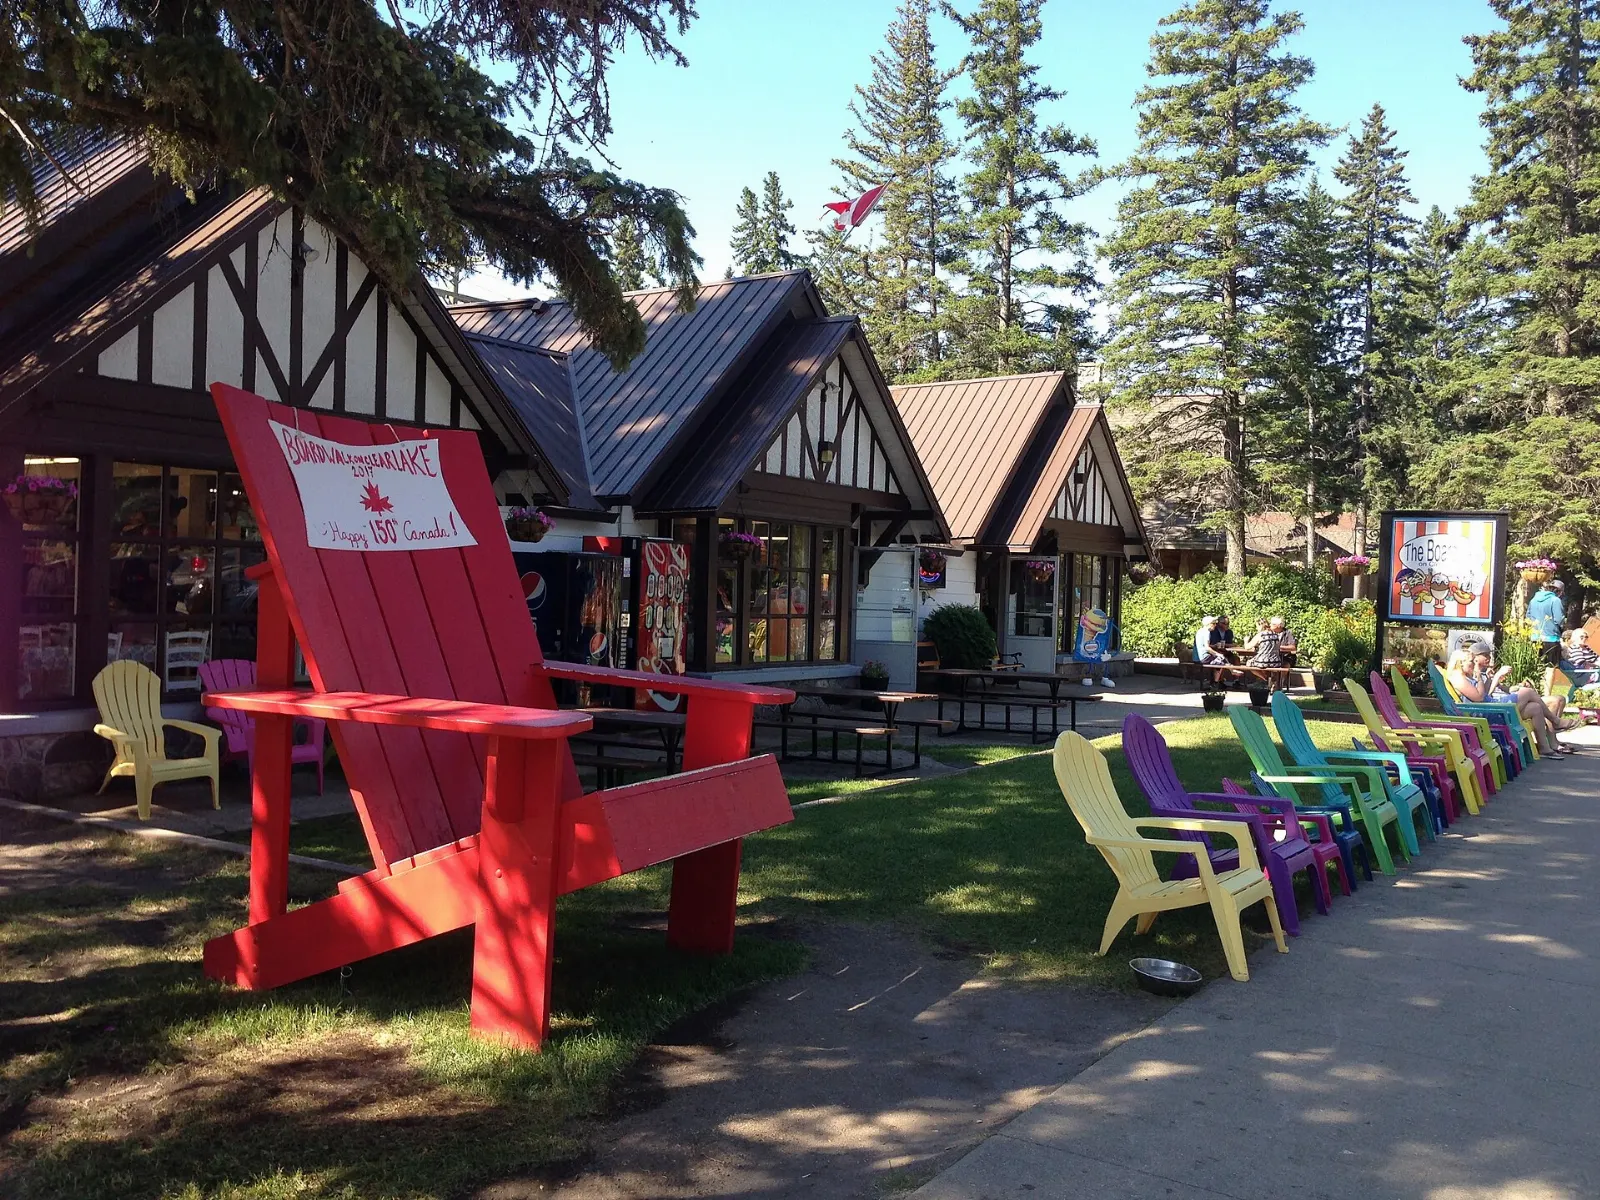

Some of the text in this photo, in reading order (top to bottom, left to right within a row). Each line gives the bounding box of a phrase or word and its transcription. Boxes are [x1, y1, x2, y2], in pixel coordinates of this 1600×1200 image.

[282, 428, 354, 465] BOARDWALK
[365, 451, 396, 470] CLEAR
[391, 444, 437, 477] LAKE
[352, 466, 374, 478] 2017
[329, 521, 369, 549] Happy
[1405, 543, 1424, 562] The
